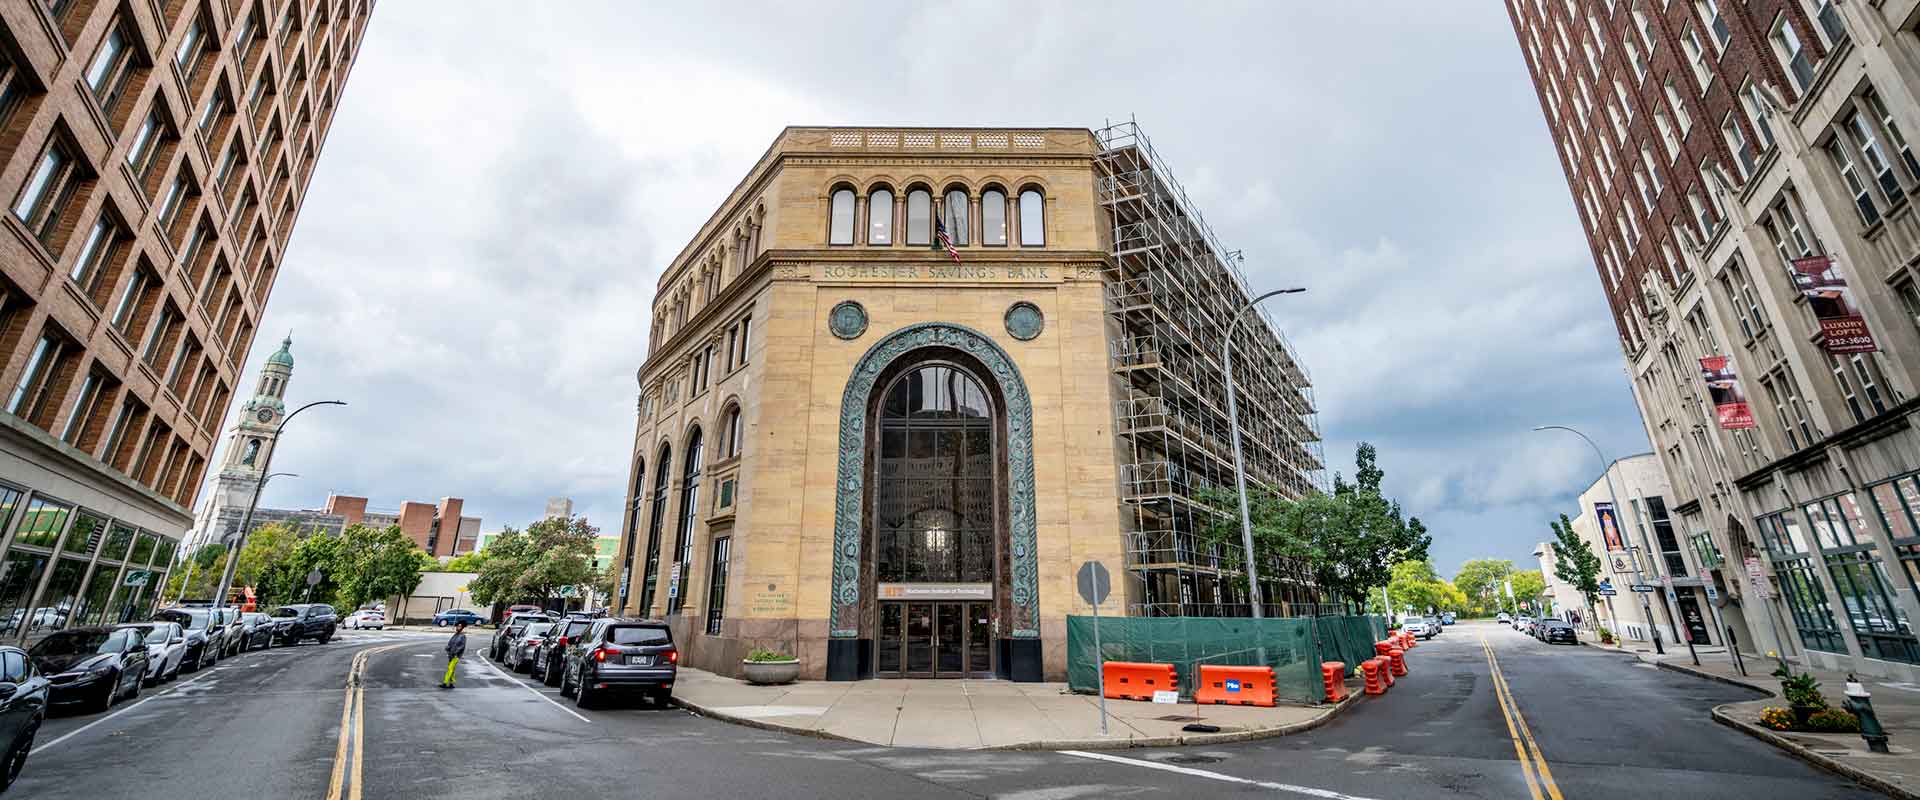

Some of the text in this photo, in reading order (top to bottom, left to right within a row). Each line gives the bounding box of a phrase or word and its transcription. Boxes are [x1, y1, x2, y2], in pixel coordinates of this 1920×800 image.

[824, 266, 1049, 279] ROCHESTER SAVINGS BANK
[1823, 320, 1864, 329] LUXURY
[1830, 328, 1862, 336] LOFTS
[1828, 336, 1871, 346] 232-3600
